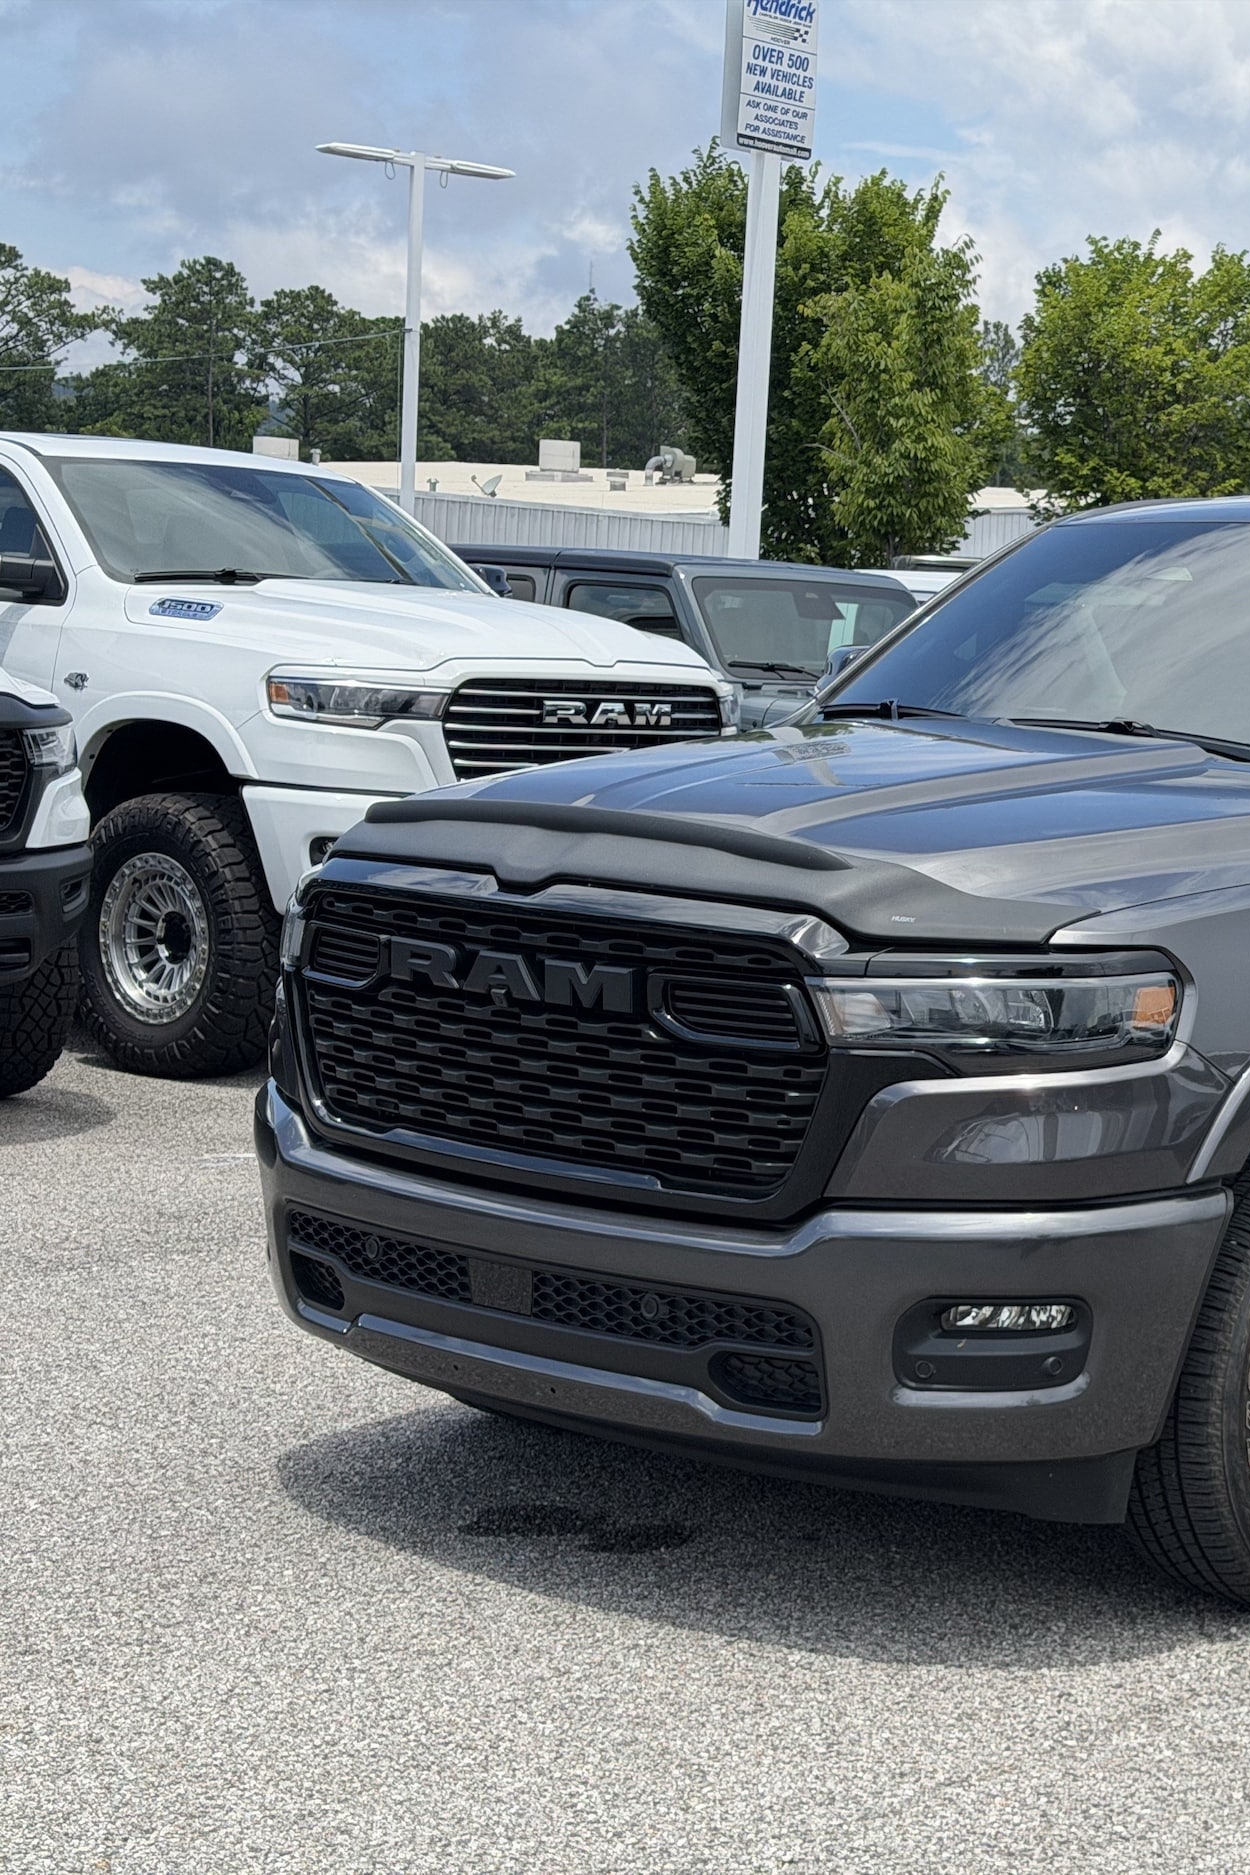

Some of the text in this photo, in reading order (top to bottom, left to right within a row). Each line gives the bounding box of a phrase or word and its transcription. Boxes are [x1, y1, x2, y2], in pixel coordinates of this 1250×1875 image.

[752, 44, 809, 72] OVER 500
[746, 62, 814, 89] NEW VEHICLES
[753, 80, 805, 103] AVAILABLE
[746, 99, 808, 120] ASK ONE OF OUR
[745, 122, 806, 144] FOR ASSISTANCE
[753, 113, 799, 130] ASSOCIATES
[162, 600, 212, 613] 1500
[542, 700, 672, 725] RAM
[390, 935, 634, 1013] RAM
